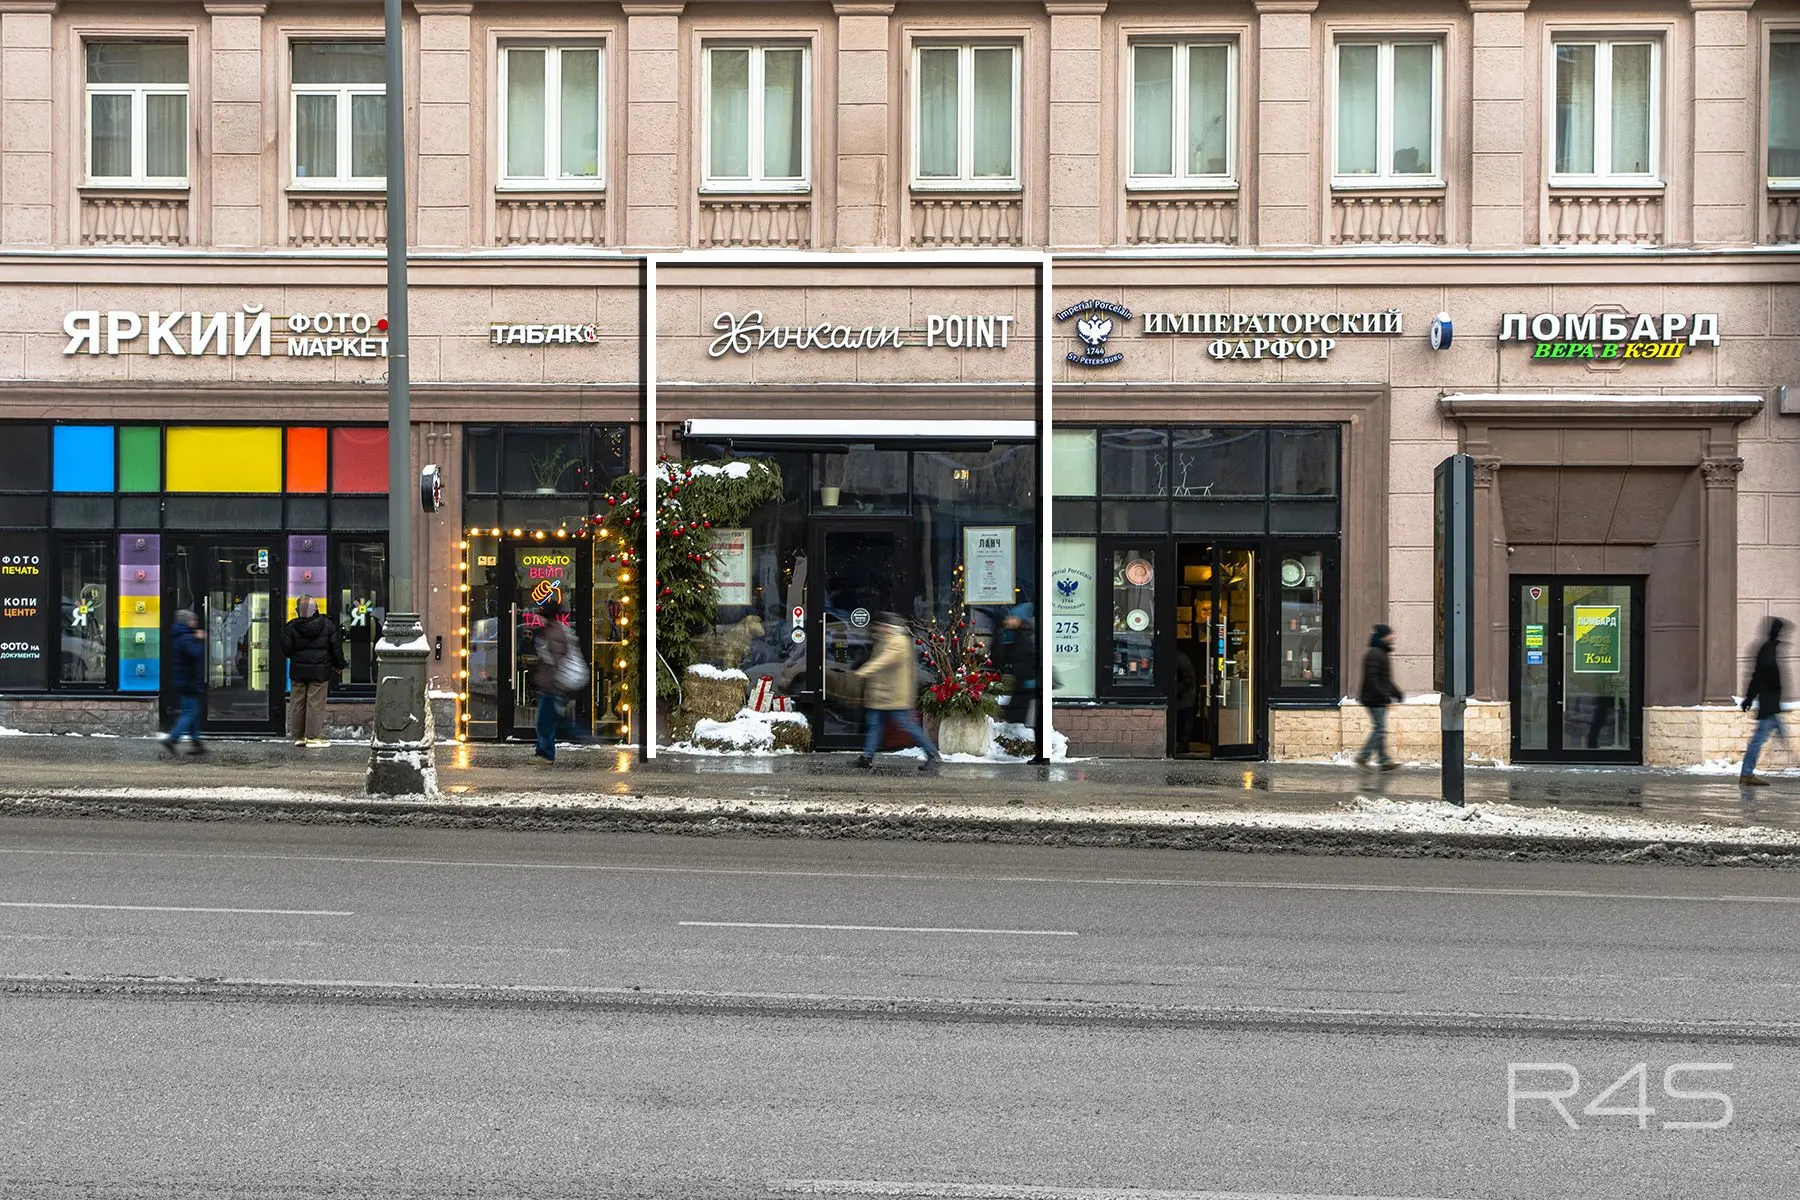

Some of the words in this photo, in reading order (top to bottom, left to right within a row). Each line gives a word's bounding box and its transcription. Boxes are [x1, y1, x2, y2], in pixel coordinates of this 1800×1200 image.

[1057, 300, 1093, 320] Imperial
[1094, 300, 1133, 320] Porcelain
[287, 312, 372, 334] ФОТО
[1142, 308, 1404, 334] ИМПЕРАТОРСКИЙ
[63, 303, 272, 356] ЯРКИЙ
[927, 314, 1014, 348] POINT
[1499, 313, 1721, 347] ЛОМБАРД
[287, 337, 389, 358] МАРКЕТ
[1207, 338, 1337, 360] ФАРФОР
[1532, 343, 1595, 358] ВЕРА
[1600, 343, 1619, 358] В
[1623, 343, 1686, 358] КЭШ
[979, 539, 1001, 548] ЛАНЧ
[2, 556, 39, 564] ФОТО
[523, 555, 570, 565] ОТКРЫТО
[2, 566, 39, 575] ПЕЧАТЬ
[529, 565, 563, 578] ВЕЙП
[4, 598, 37, 606] КОПИ
[4, 608, 37, 617] ЦЕНТР
[523, 613, 571, 627] ТАК
[1055, 622, 1080, 634] 275
[0, 642, 29, 651] ФОТО
[1055, 645, 1080, 653] ИФЗ
[1584, 653, 1613, 664] Кэш
